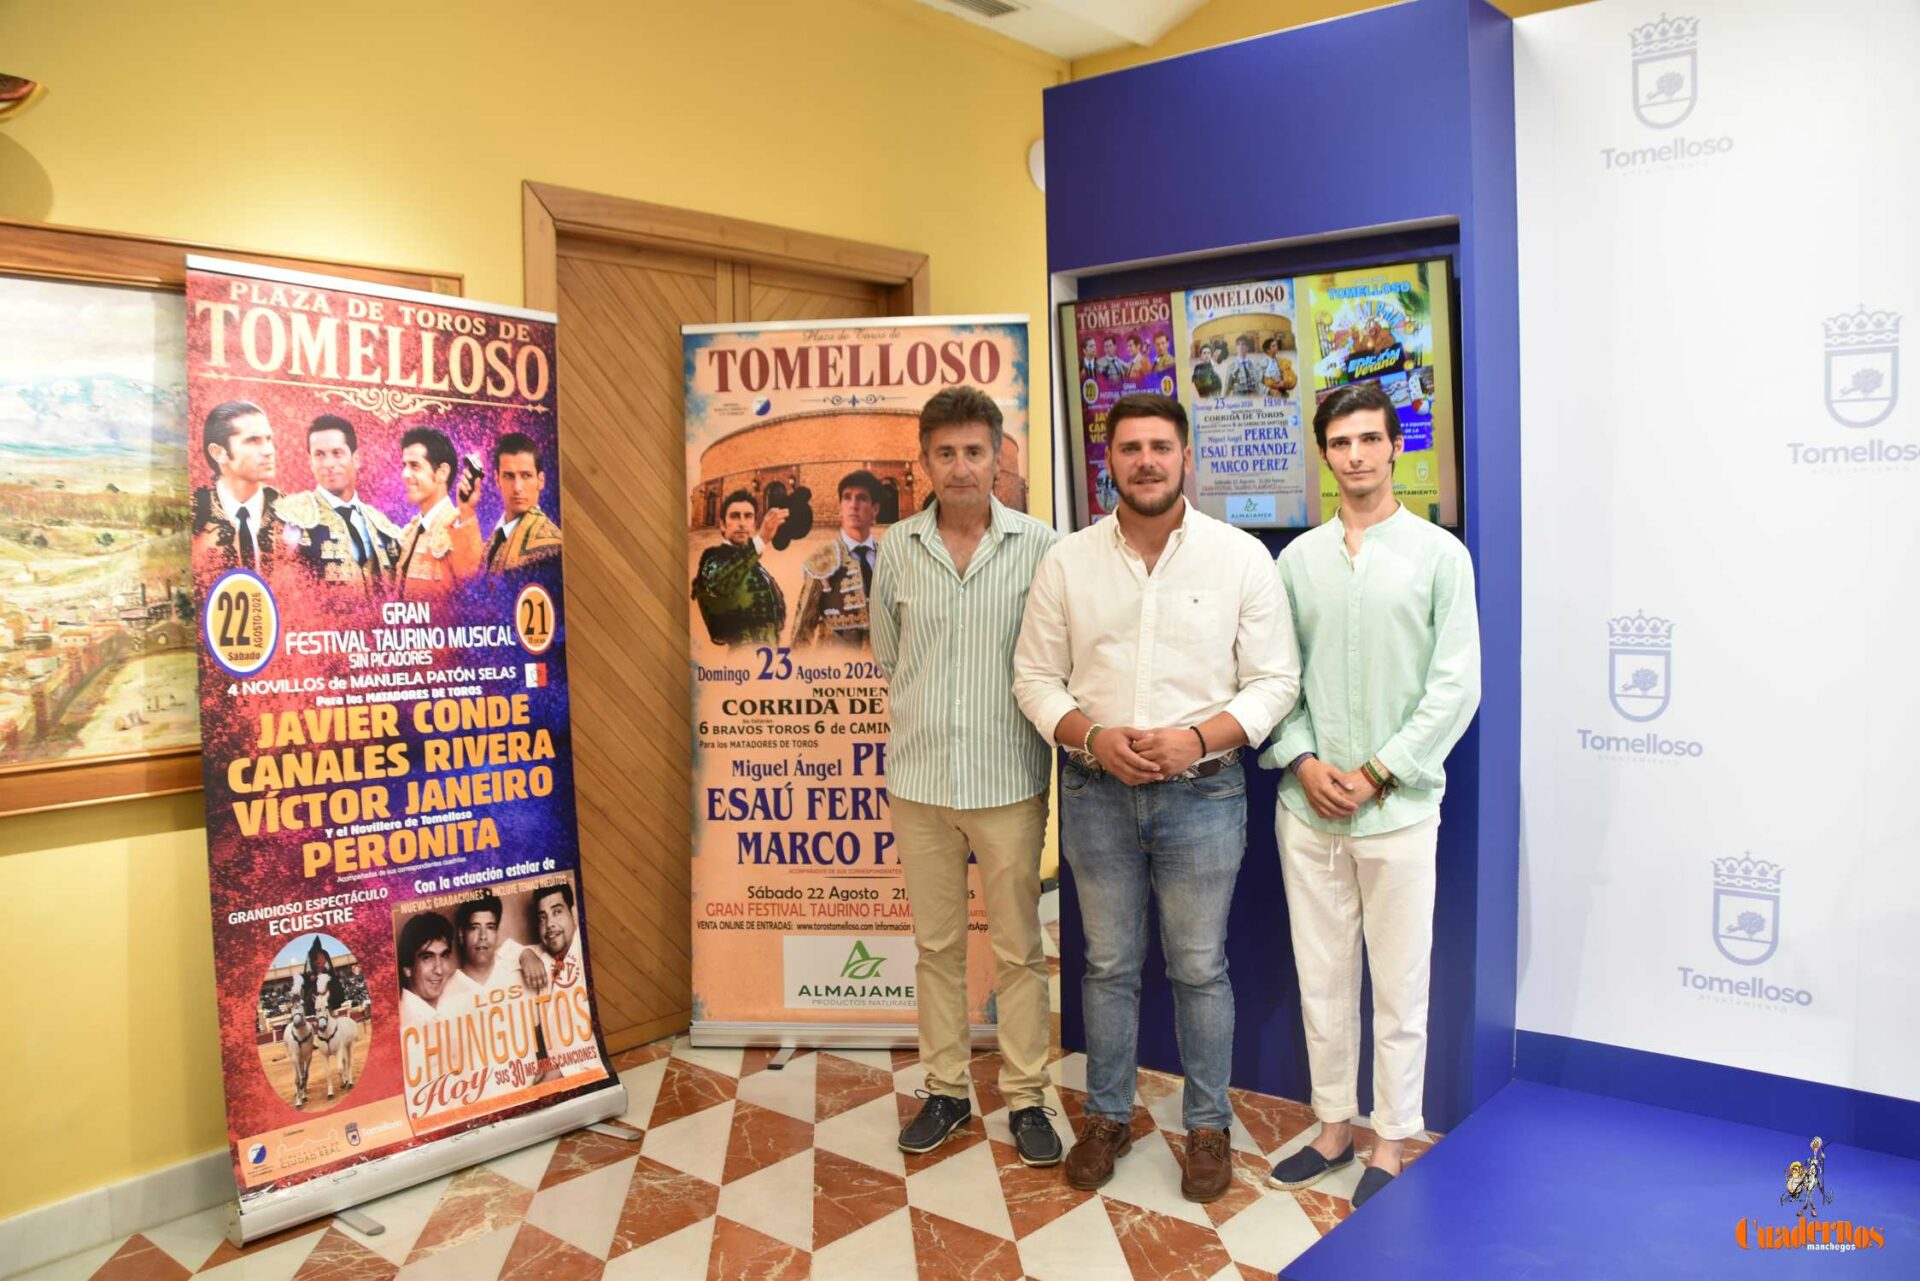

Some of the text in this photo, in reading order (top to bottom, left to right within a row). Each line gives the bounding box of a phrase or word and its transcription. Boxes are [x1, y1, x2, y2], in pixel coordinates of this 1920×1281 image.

[1600, 136, 1734, 170] Tomelloso
[1192, 285, 1285, 311] TOMELLOSO
[1327, 280, 1411, 300] TOMELLOSO
[230, 280, 530, 343] PLAZA DE TOROS DE
[1077, 303, 1170, 330] TOMELLOSO
[196, 301, 550, 401] TOMELLOSO
[708, 339, 1001, 392] TOMELLOSO
[1204, 413, 1240, 422] CORRIDA
[1243, 412, 1253, 420] DE
[1256, 411, 1284, 419] TOROS
[1244, 427, 1288, 441] PERERA
[1786, 438, 1920, 464] Tomellos
[1211, 459, 1249, 473] MARCO
[218, 591, 250, 646] 22
[382, 602, 430, 624] GRAN
[522, 598, 549, 635] 21
[285, 625, 516, 655] FESTIVAL TAURINO MUSICAL
[349, 650, 433, 668] SIN PICADORES
[698, 666, 750, 685] Domingo
[756, 647, 793, 680] 23
[796, 665, 841, 684] Agosto
[227, 666, 516, 696] 4 NOVILLOS de MANUELA PATÓN SELAS
[812, 687, 889, 698] MONUMEN
[316, 685, 482, 706] Para los MATADORES DE TOROS
[722, 698, 884, 716] CORRIDA DE
[257, 694, 530, 749] JAVIER CONDE
[700, 721, 709, 735] 6
[712, 725, 763, 735] BRAVOS
[766, 725, 810, 734] TOROS
[814, 720, 825, 734] 6
[830, 722, 846, 735] de
[699, 739, 818, 749] Para los MATADORES DE TOROS
[1577, 728, 1704, 757] Tomelloso
[227, 729, 555, 794] CANALES RIVERA
[732, 758, 788, 781] Miguel
[793, 753, 843, 781] Ángel
[232, 765, 554, 836] VÍCTOR JANEIRO
[707, 781, 794, 821] ESAÚ
[325, 810, 472, 838] Y el Novillero de Tomelloso
[303, 818, 501, 878] PERONITA
[737, 831, 861, 866] MARCO
[414, 857, 555, 894] Con la actuación estelar de
[228, 887, 388, 925] GRANDIOSO ESPECTÁCULO
[400, 899, 433, 914] NUEVAS
[433, 889, 485, 910] GRABACIONES
[747, 885, 803, 900] Sábado
[807, 887, 824, 900] 22
[829, 886, 879, 901] Agosto
[269, 907, 355, 936] ECUESTRE
[705, 903, 913, 918] GRAN FESTIVAL TAURINO FLAM
[697, 921, 718, 930] VENTA
[719, 921, 744, 930] ONLINE
[746, 921, 755, 930] DE
[796, 921, 873, 931] www.torostomelloso.com
[474, 985, 523, 1008] LOS
[798, 985, 914, 998] ALMAJAME
[1677, 966, 1813, 1006] Tomelloso
[811, 999, 917, 1007] PRODUCTOS NATURALES
[401, 986, 593, 1087] CHUNGUITOS
[494, 1069, 510, 1085] SUS
[509, 1059, 526, 1088] 30
[557, 1046, 598, 1068] CANCIONES
[412, 1067, 495, 1119] Hoy
